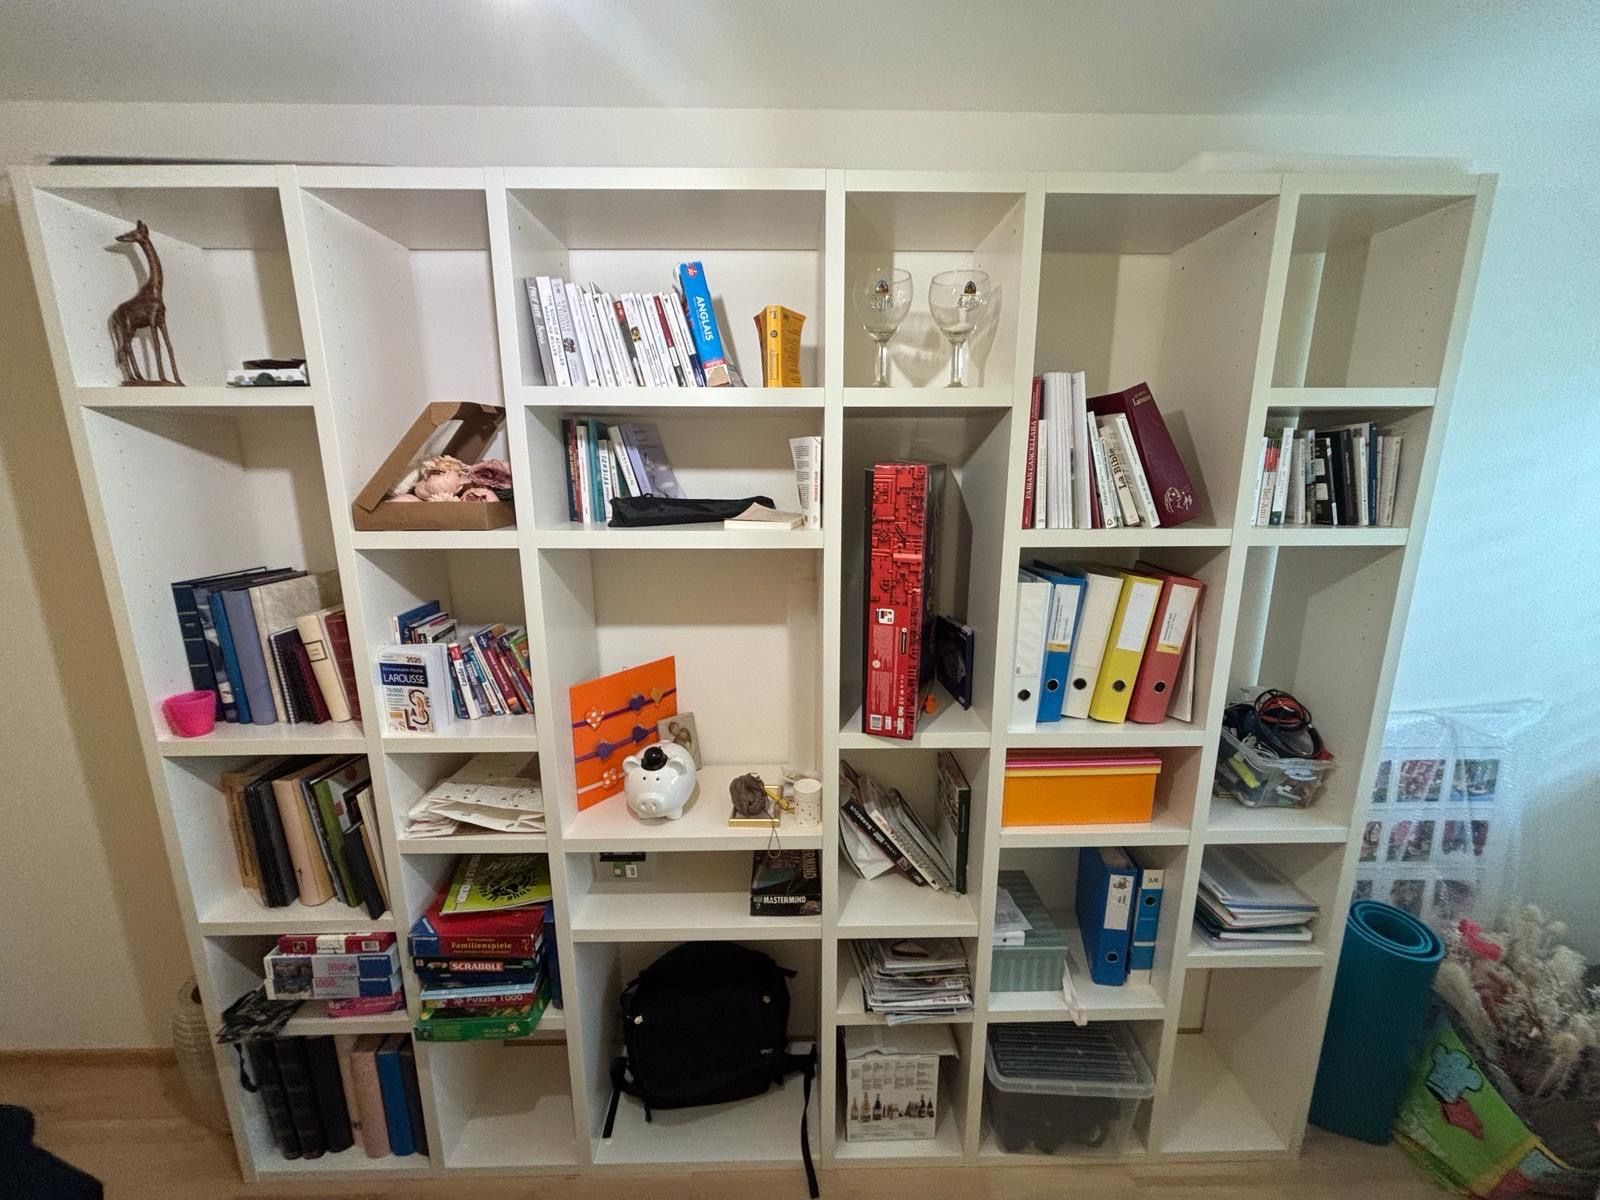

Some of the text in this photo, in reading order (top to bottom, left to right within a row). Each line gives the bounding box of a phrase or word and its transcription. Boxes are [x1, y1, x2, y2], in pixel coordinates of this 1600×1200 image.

[695, 295, 714, 341] ANGLAIS
[1026, 420, 1037, 471] CANCELLARA
[1107, 447, 1127, 490] La Bible
[1025, 471, 1033, 500] FABIAN
[406, 656, 422, 664] 2020
[383, 674, 426, 685] LAROUSSE
[457, 668, 467, 687] Canada
[763, 896, 807, 904] MASTERMIND
[451, 962, 503, 971] SCRABBLE
